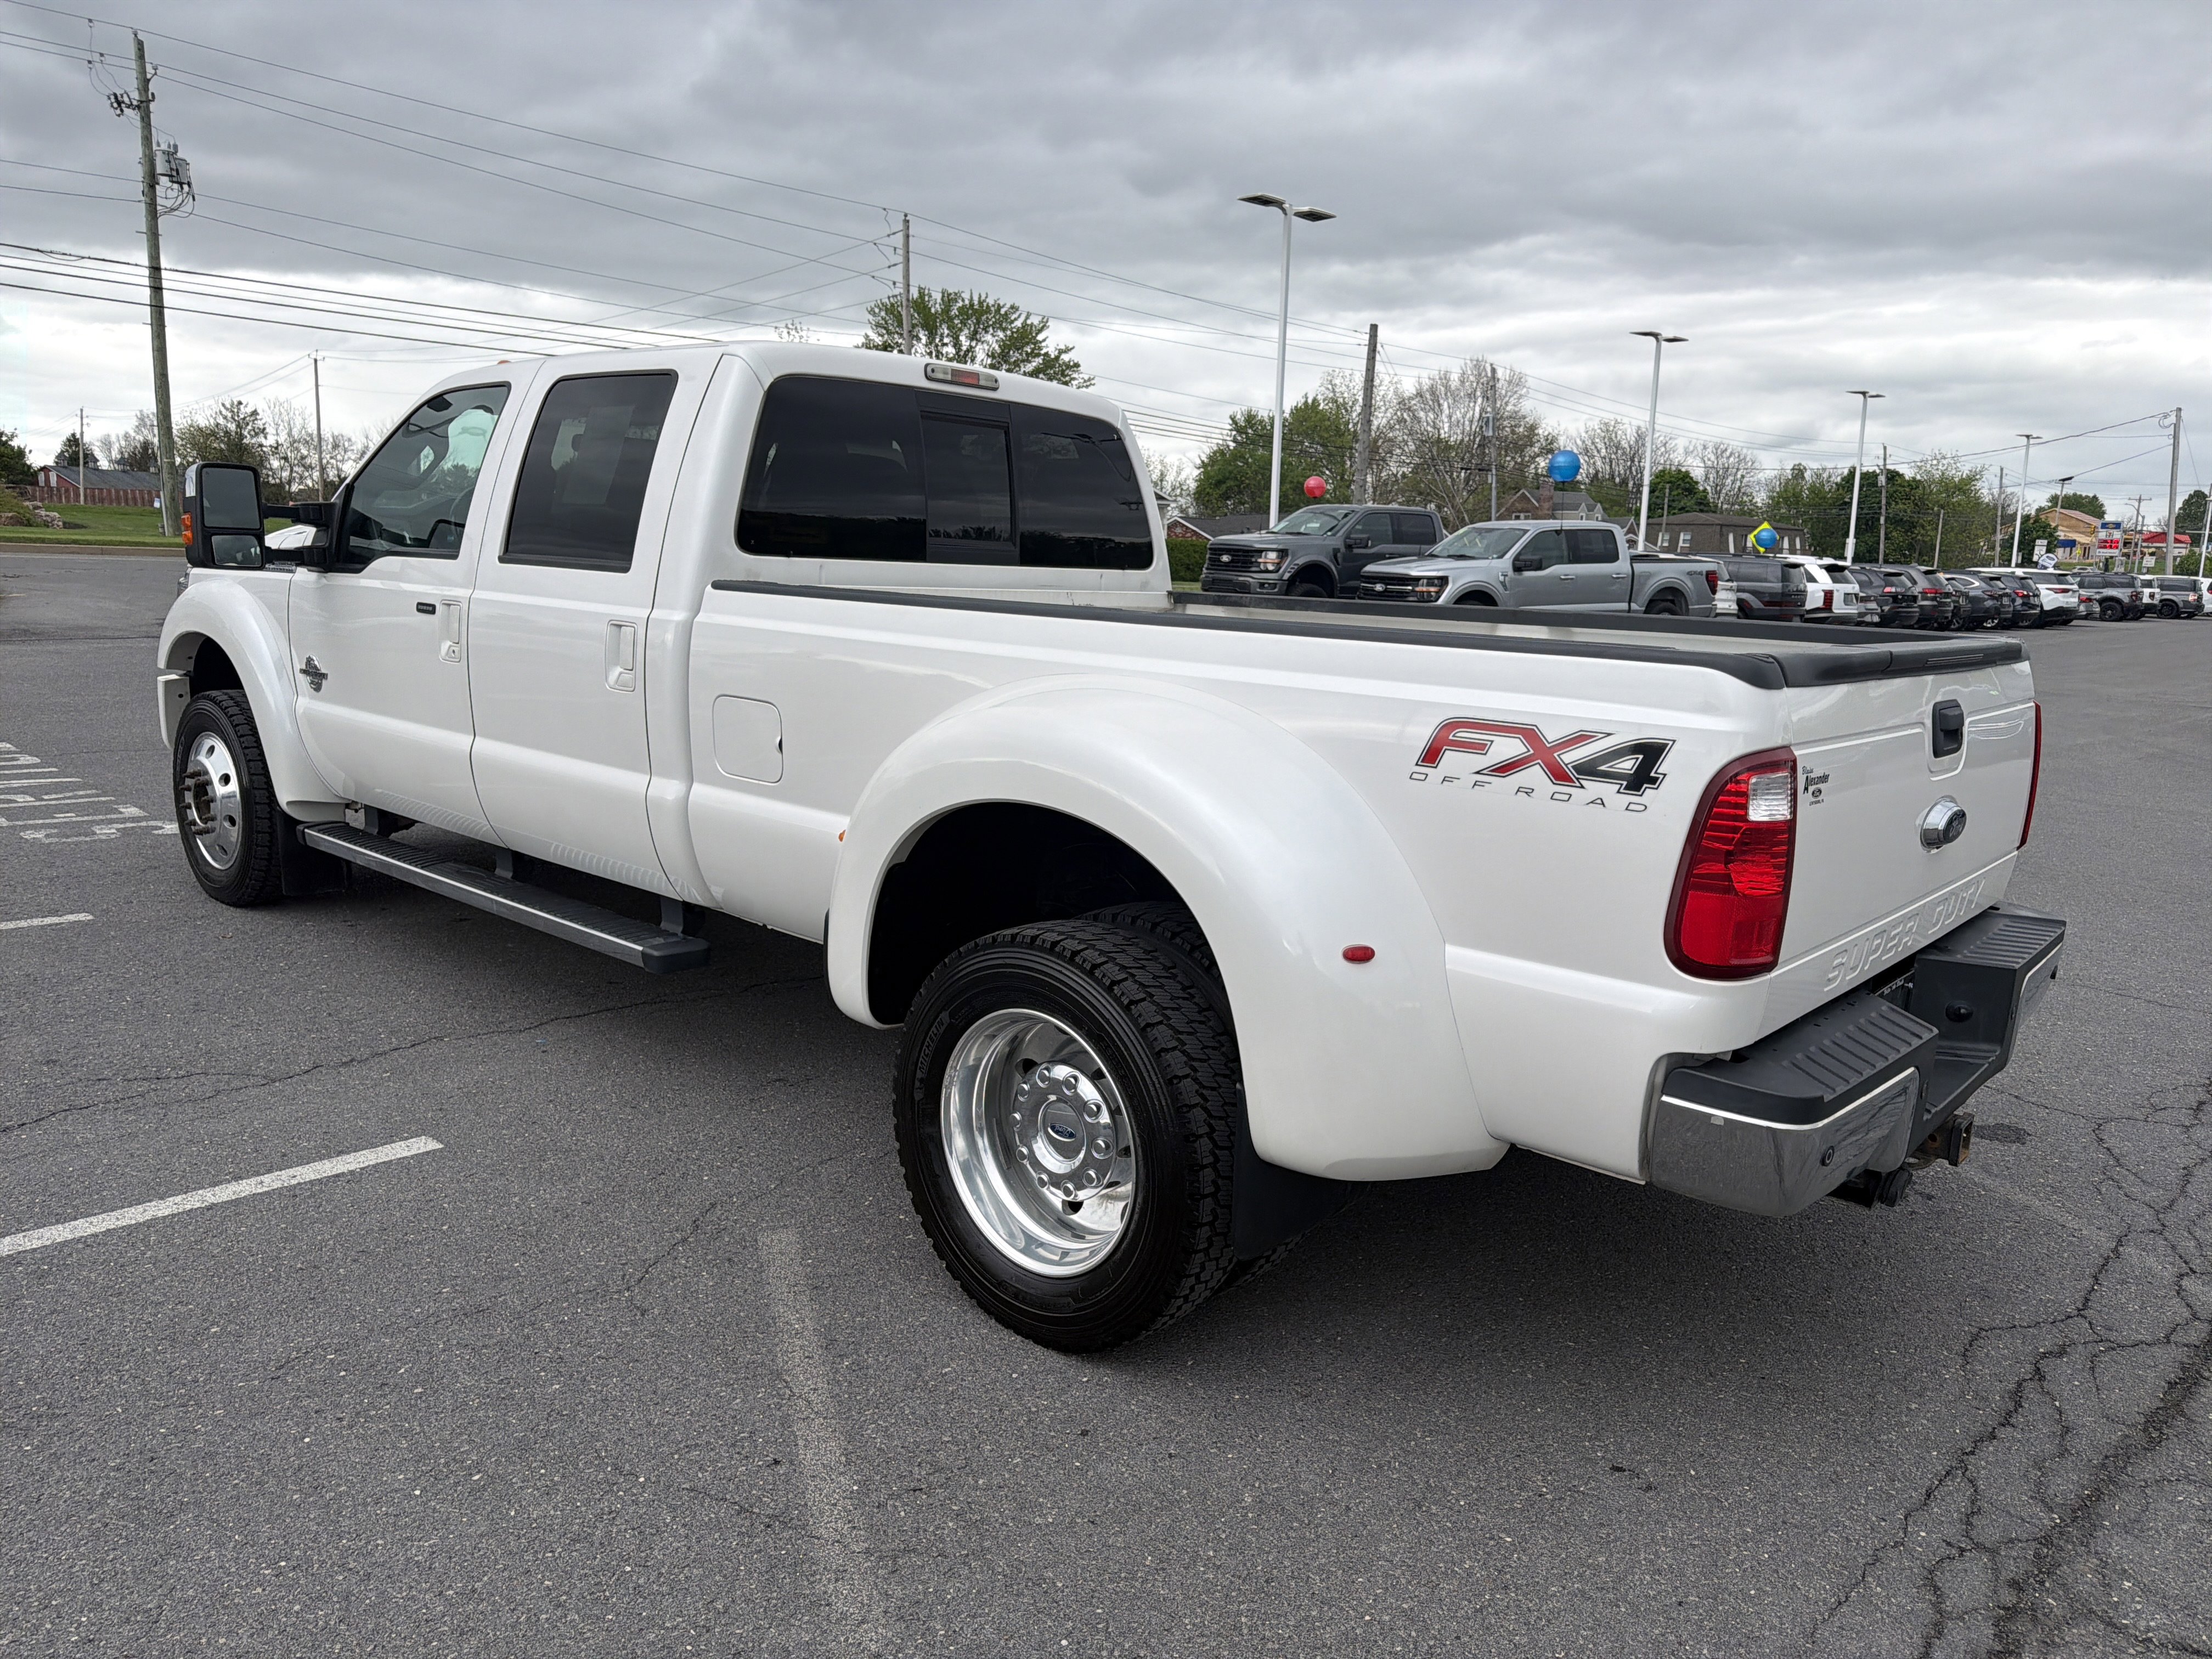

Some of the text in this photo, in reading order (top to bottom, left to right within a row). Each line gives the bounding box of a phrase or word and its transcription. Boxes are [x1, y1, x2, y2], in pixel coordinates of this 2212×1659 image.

[1414, 716, 1677, 797] FX4
[1409, 771, 1648, 813] OFF ROAD
[1803, 772, 1830, 795] Alexander
[1823, 877, 1986, 992] SUPER DUTY
[918, 1017, 945, 1074] MICHELIN
[1054, 1125, 1071, 1138] Ford
